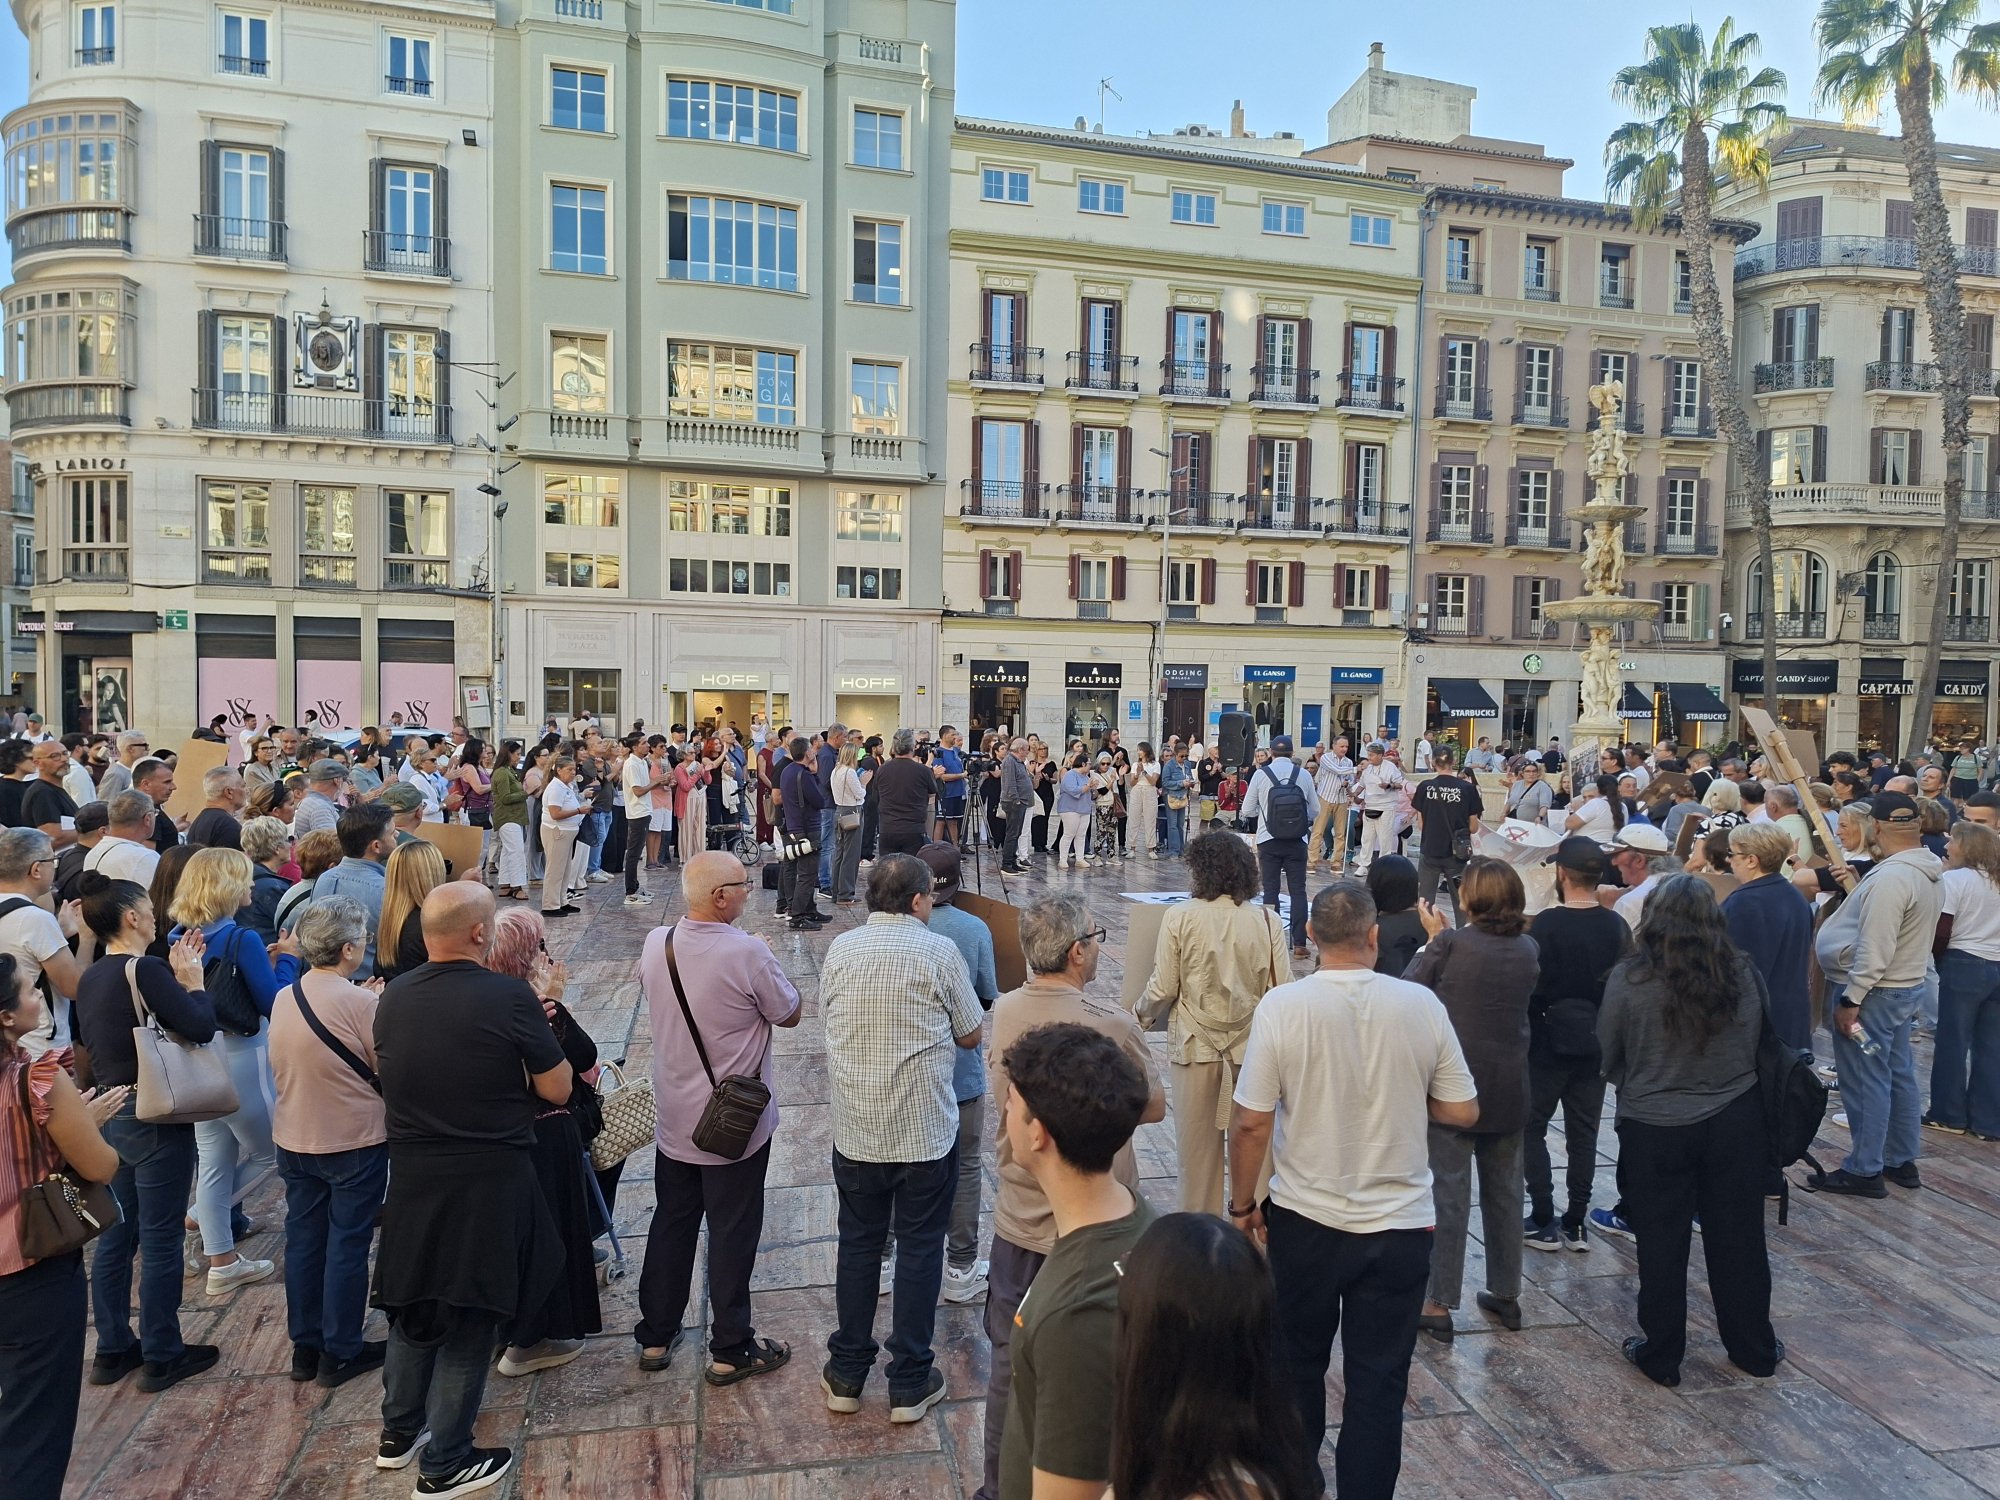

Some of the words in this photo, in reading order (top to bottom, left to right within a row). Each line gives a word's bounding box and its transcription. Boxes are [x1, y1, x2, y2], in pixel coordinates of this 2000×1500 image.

[701, 674, 760, 686] HOFF
[841, 677, 896, 689] HOFF
[973, 674, 1027, 683] SCALPERS
[1068, 676, 1120, 684] SCALPERS
[1776, 675, 1807, 683] CANDY
[1860, 683, 1914, 695] CAPTAIN
[1944, 683, 1987, 695] CANDY
[1450, 709, 1496, 717] STARBUCKS
[1616, 710, 1652, 718] TARBUCKS
